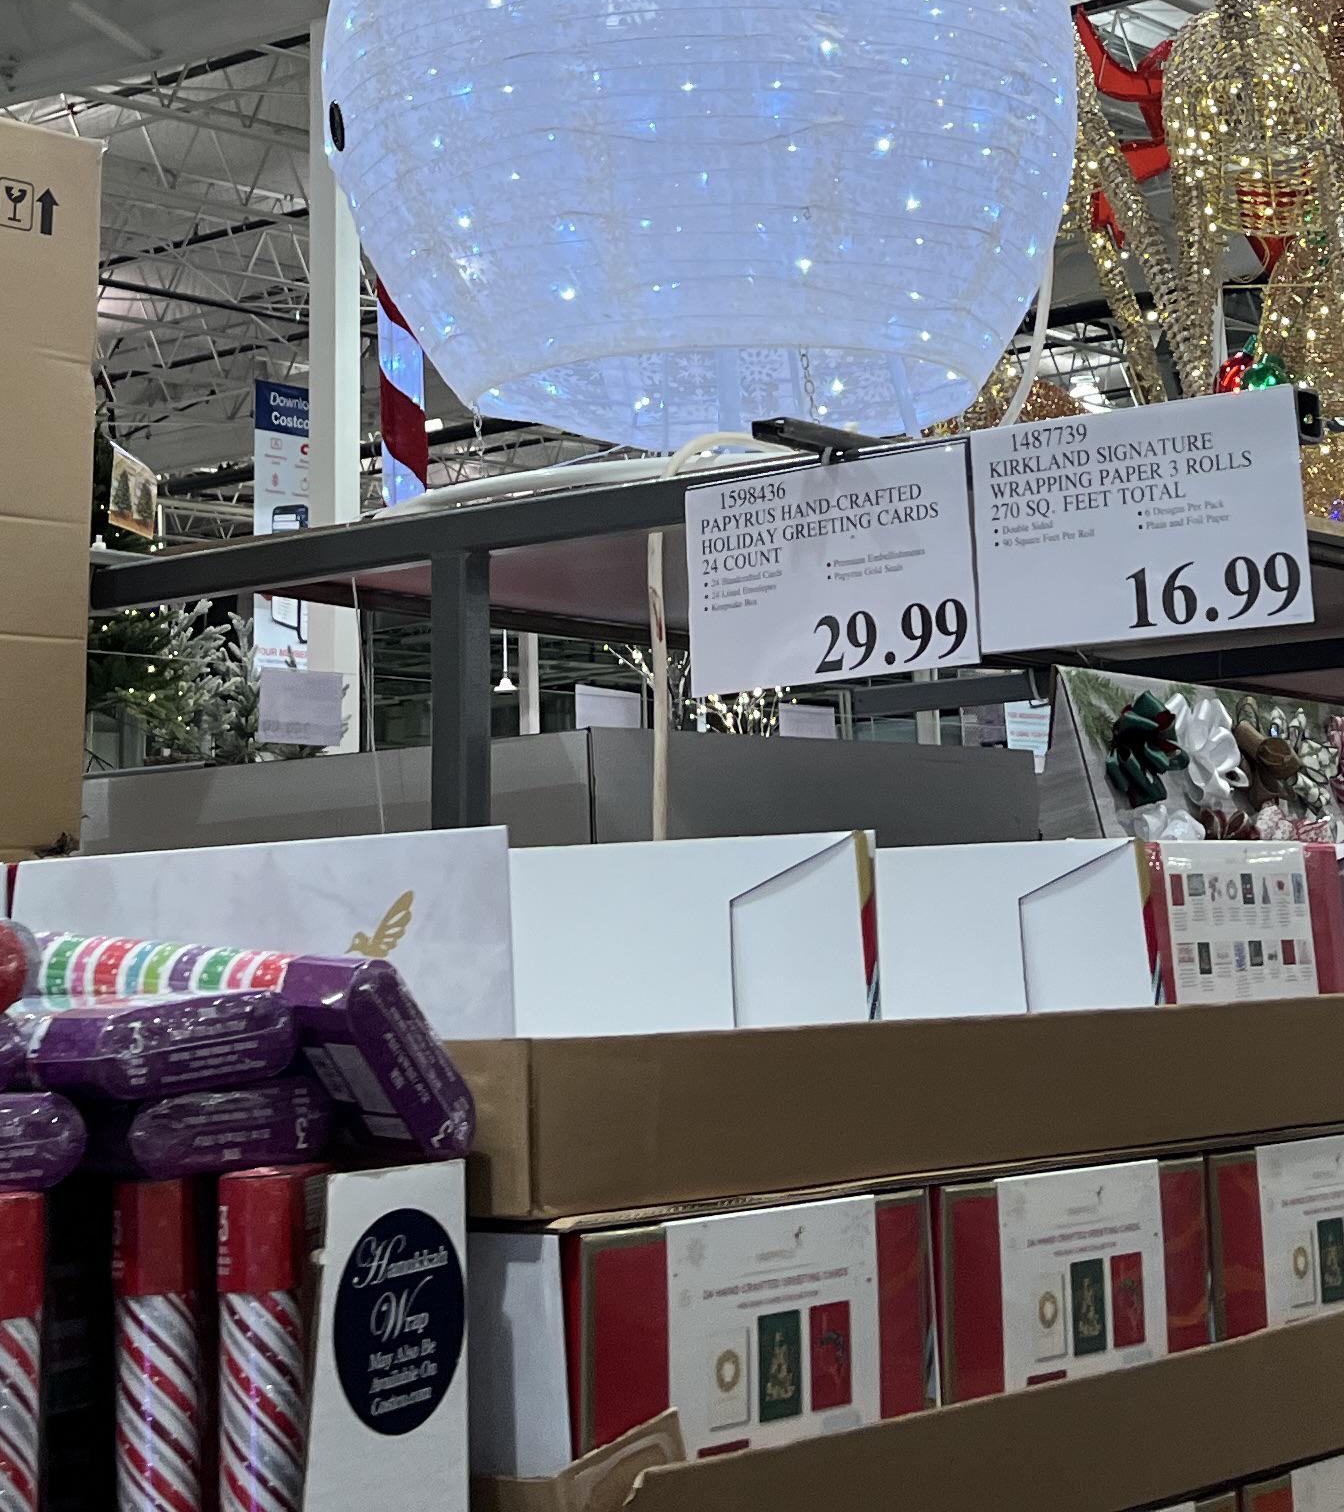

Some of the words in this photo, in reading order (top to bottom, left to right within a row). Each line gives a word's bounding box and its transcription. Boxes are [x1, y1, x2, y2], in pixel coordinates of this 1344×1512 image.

[990, 449, 1091, 479] KIRKLAND
[1097, 432, 1214, 463] SIGNATURE
[1010, 423, 1087, 452] 1487739
[720, 482, 786, 510] 1598436
[991, 470, 1093, 500] WRAPPING
[1099, 460, 1162, 486] PAPER
[1169, 459, 1179, 478] 3
[1186, 450, 1253, 475] ROLLS
[701, 508, 776, 535] PAPYRUS
[781, 483, 922, 522] HAND-CRAFTED
[991, 502, 1020, 522] 270
[1026, 498, 1056, 518] SQ.
[1063, 490, 1111, 513] FEET
[1121, 481, 1186, 506] TOTAL
[702, 528, 777, 555] HOLIDAY
[783, 512, 871, 541] GREETING
[877, 502, 939, 527] CARDS
[703, 559, 718, 575] 24
[723, 547, 783, 571] COUNT
[1126, 551, 1301, 629] 16.99
[813, 598, 968, 674] 29.99
